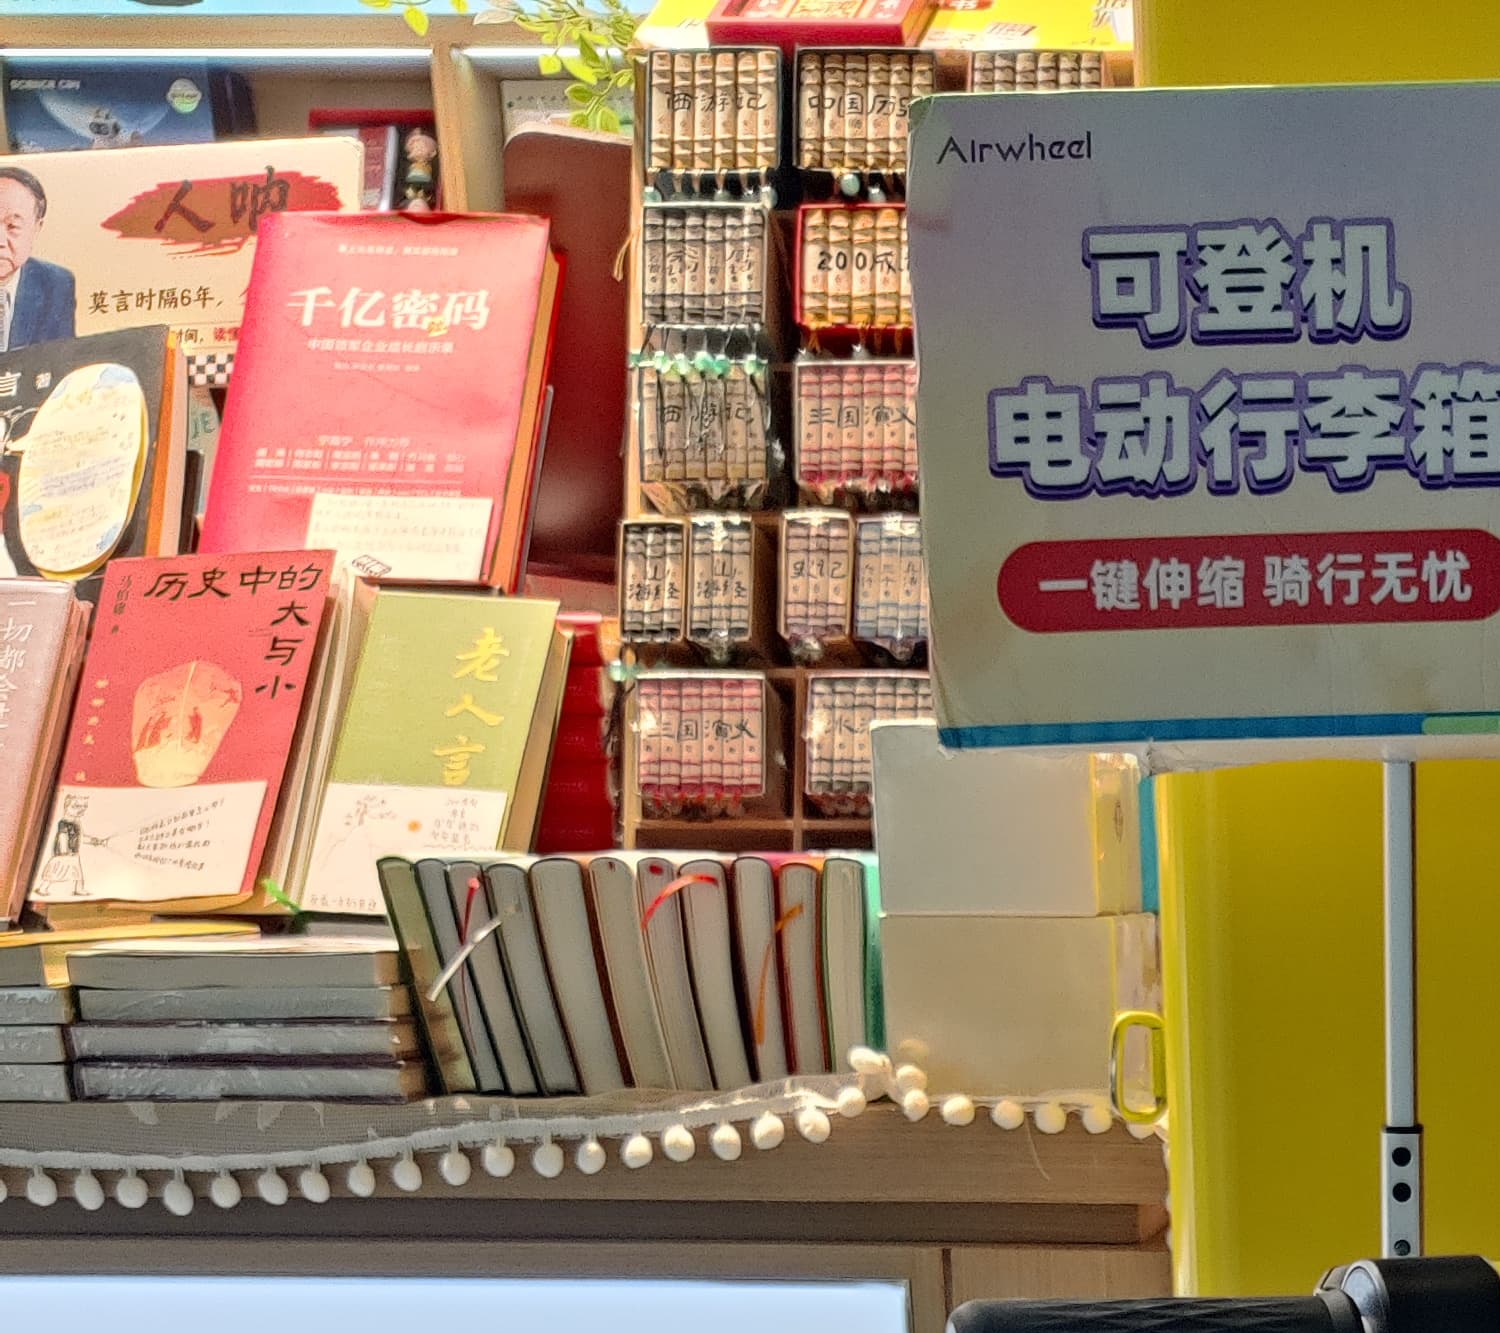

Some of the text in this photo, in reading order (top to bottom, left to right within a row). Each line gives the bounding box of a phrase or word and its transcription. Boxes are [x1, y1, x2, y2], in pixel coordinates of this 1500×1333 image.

[937, 131, 1092, 165] Airwheel
[286, 286, 490, 331] 千亿密码
[1084, 222, 1408, 345] 可登机
[143, 563, 323, 602] 历史中的
[1037, 551, 1473, 615] 一键伸缩 骑行无忧
[255, 604, 311, 700] 大与小
[433, 627, 511, 785] 老人言
